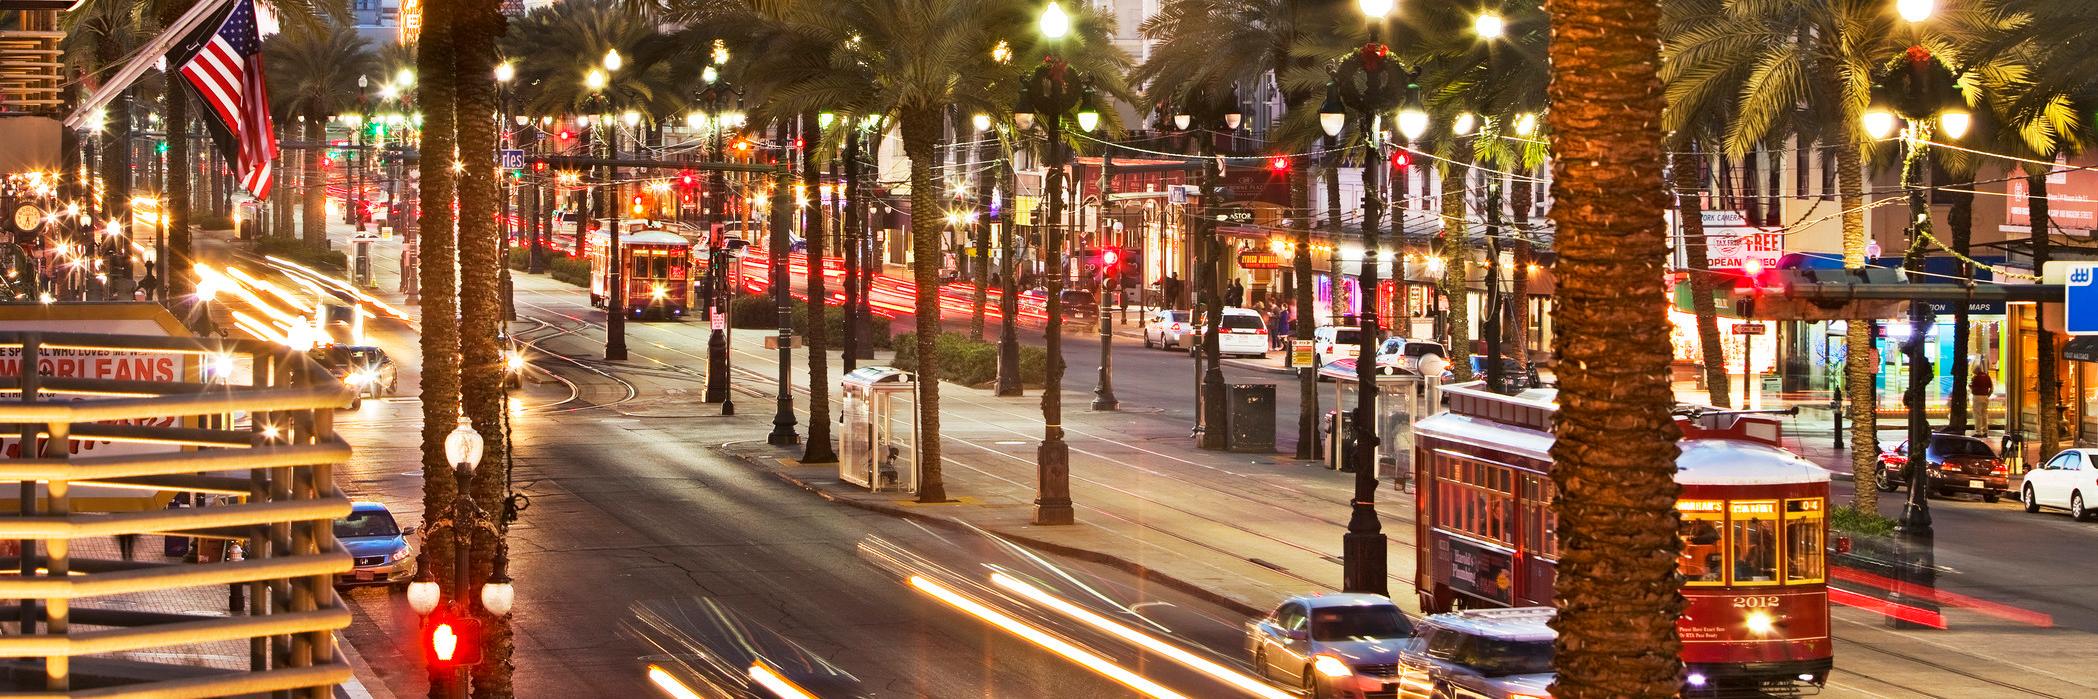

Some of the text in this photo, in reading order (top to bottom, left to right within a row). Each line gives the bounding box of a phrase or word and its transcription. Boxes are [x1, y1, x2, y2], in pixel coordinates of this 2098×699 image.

[502, 151, 522, 168] rles
[1229, 212, 1252, 220] ASTOR
[1707, 258, 1742, 267] OPEAN
[1968, 303, 1991, 311] MAPS
[52, 349, 75, 357] WHO
[38, 358, 174, 383] ORLEANS
[1733, 596, 1780, 608] 2012
